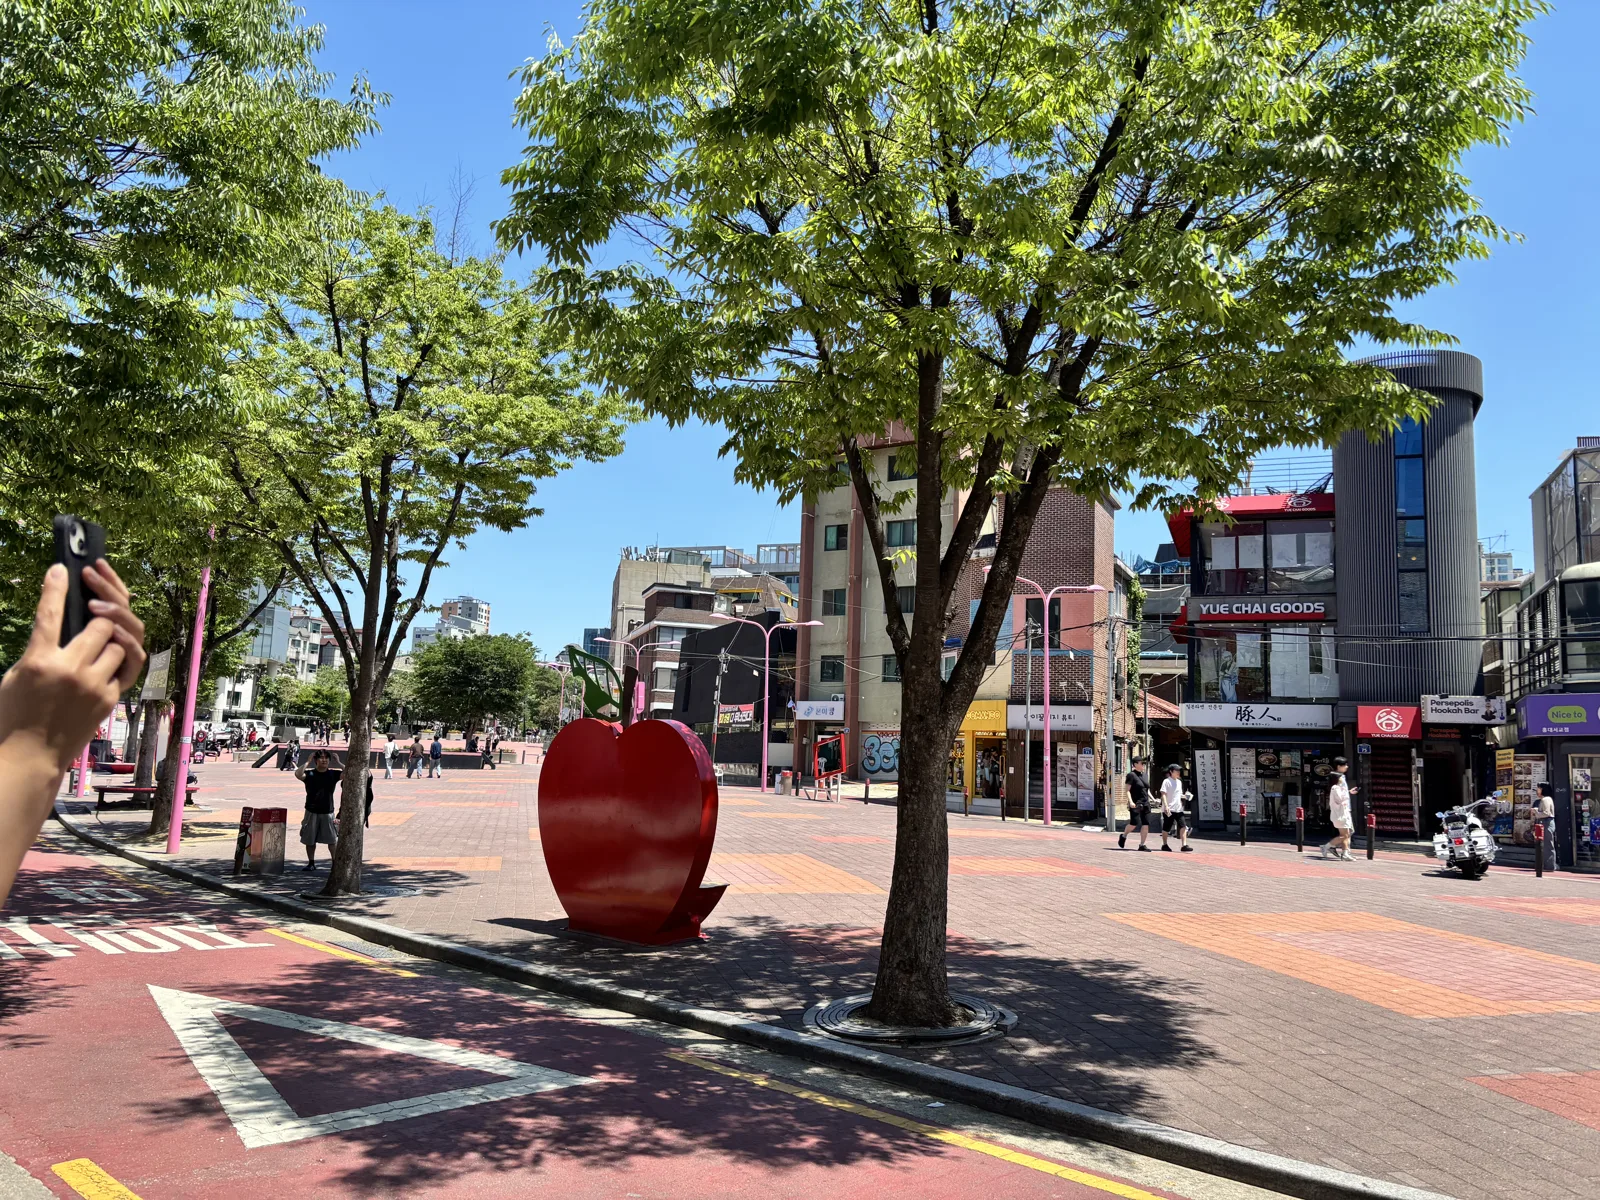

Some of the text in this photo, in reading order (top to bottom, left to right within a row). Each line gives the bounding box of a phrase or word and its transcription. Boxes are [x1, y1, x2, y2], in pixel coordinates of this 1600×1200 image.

[1200, 602, 1325, 614] YUE CHAI GOODS
[1430, 699, 1474, 707] Persepolis
[1235, 705, 1277, 722] 豚人
[1551, 711, 1571, 719] Nice
